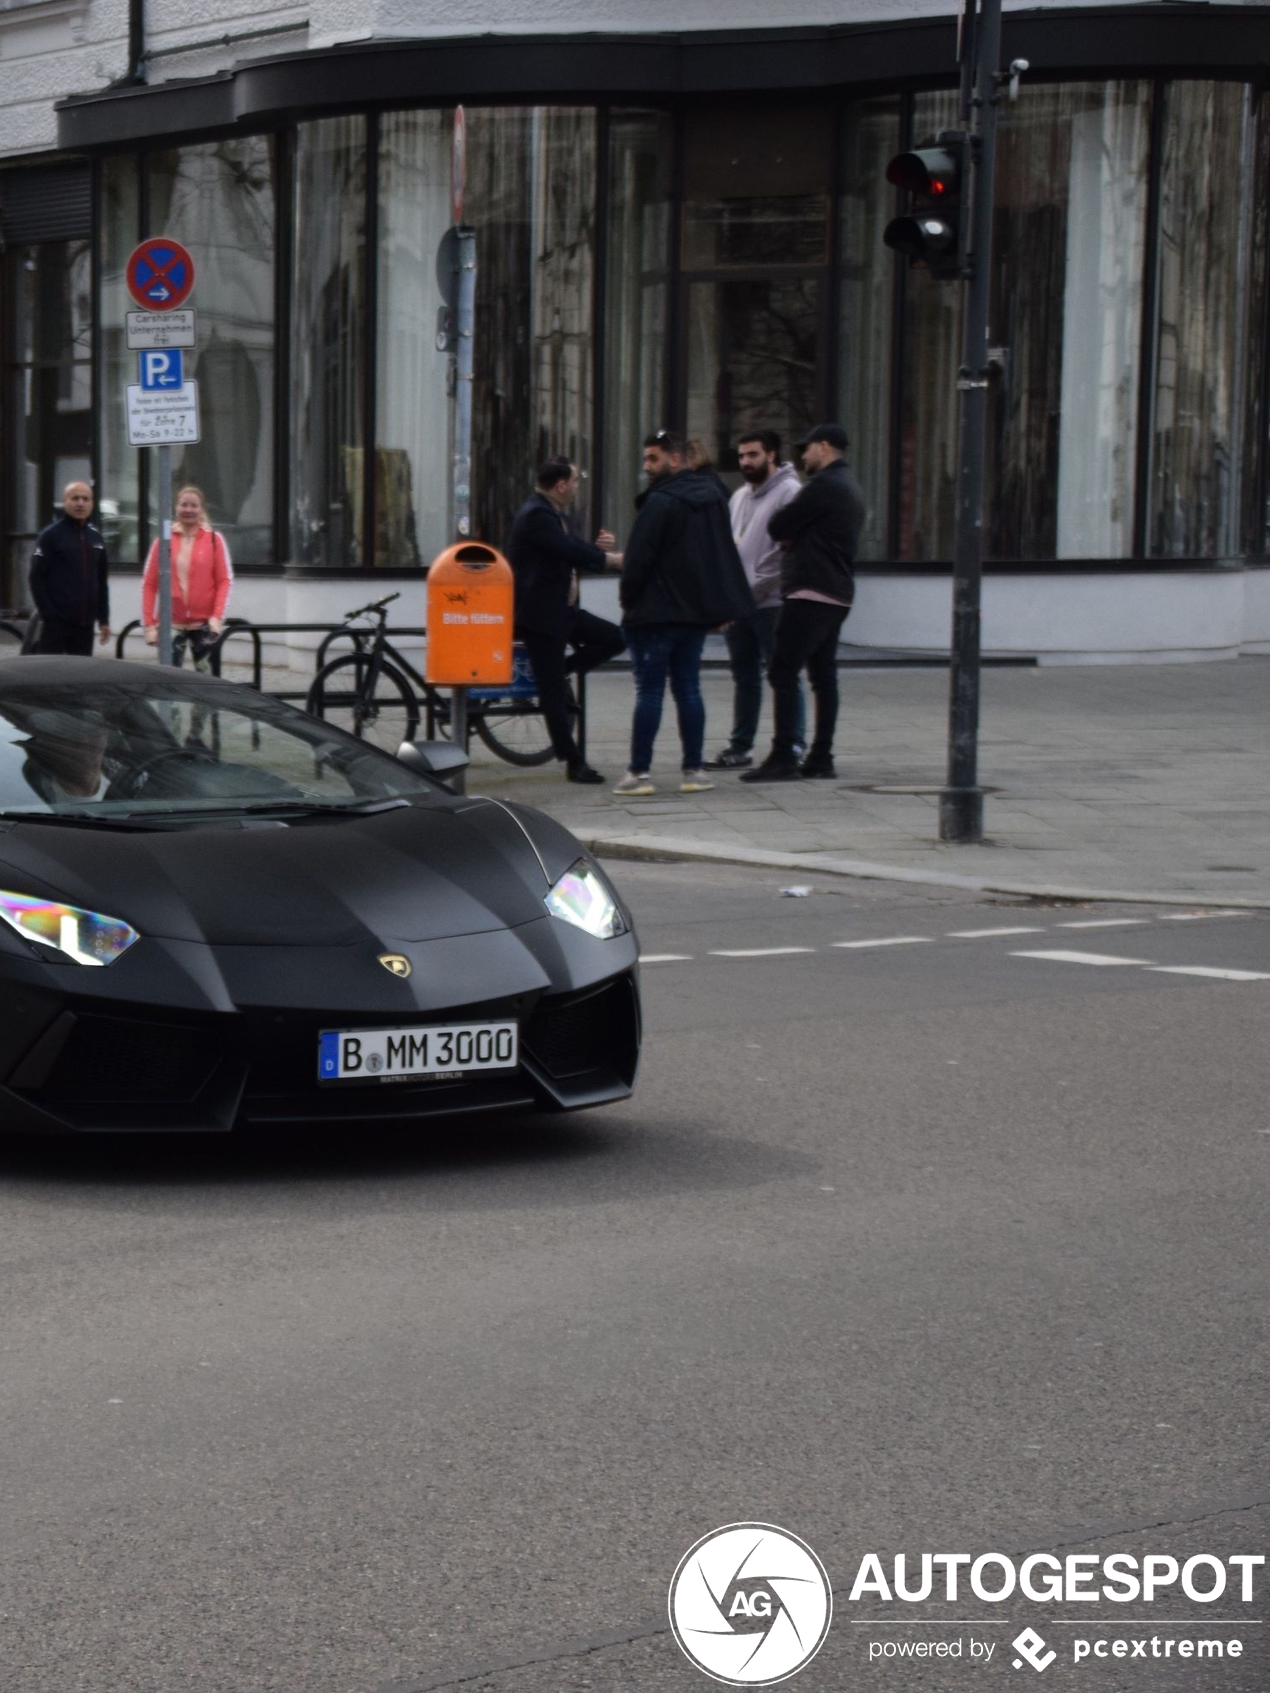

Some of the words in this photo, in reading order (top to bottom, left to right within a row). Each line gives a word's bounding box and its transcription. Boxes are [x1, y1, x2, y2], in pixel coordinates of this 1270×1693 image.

[135, 313, 186, 324] Carsharing
[130, 324, 192, 335] Unternehmen
[153, 334, 170, 345] frei
[146, 353, 170, 387] P
[178, 415, 186, 427] 7
[443, 612, 468, 625] Bitte
[342, 1037, 363, 1072] B
[387, 1033, 428, 1070] MM
[436, 1028, 513, 1066] 3000
